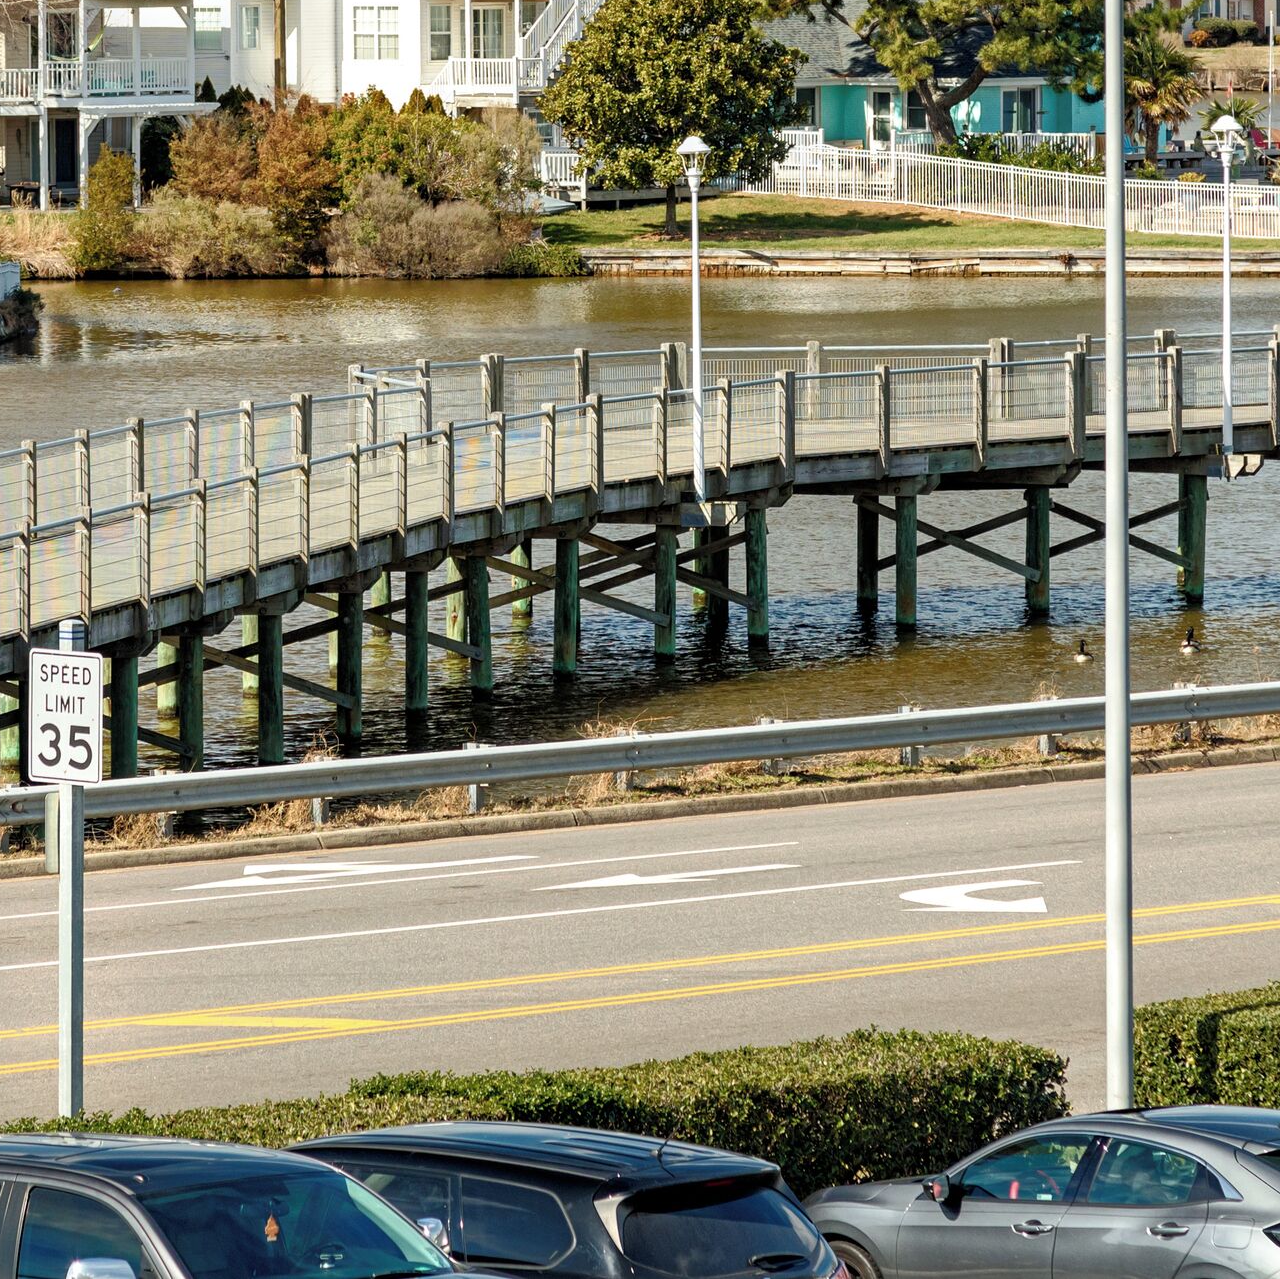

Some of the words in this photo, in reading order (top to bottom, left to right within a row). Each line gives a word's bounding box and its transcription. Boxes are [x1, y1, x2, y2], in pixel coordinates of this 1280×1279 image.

[40, 663, 92, 686] SPEED
[45, 694, 85, 715] LIMIT
[37, 722, 93, 770] 35
